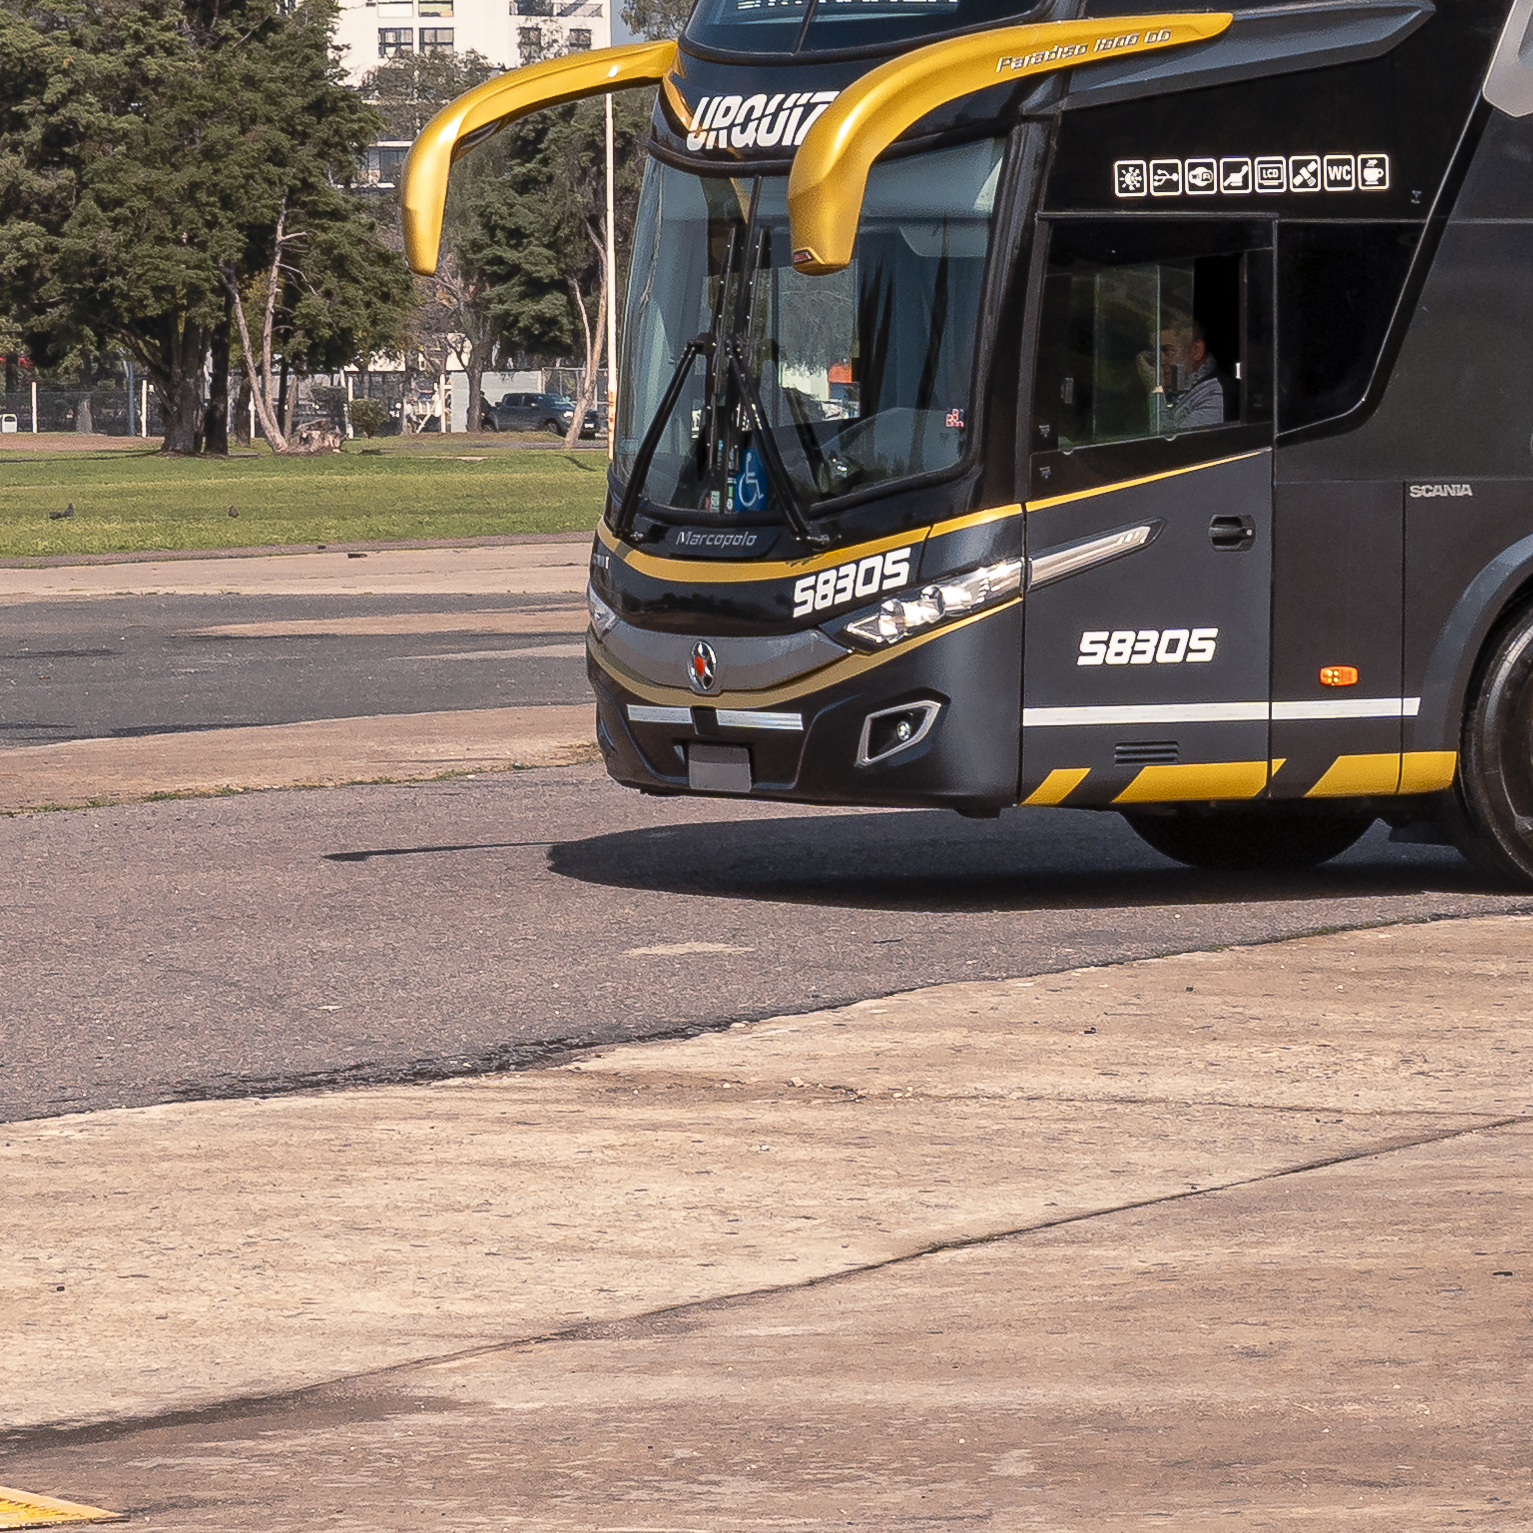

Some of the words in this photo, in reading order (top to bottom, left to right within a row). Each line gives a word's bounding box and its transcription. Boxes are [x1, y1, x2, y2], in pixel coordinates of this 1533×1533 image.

[686, 90, 841, 152] URQUIZ
[1327, 164, 1352, 181] WC
[1409, 484, 1473, 498] SCANIA
[676, 530, 758, 549] Marcopolo
[792, 546, 912, 619] 58305
[1076, 627, 1219, 666] 58305
